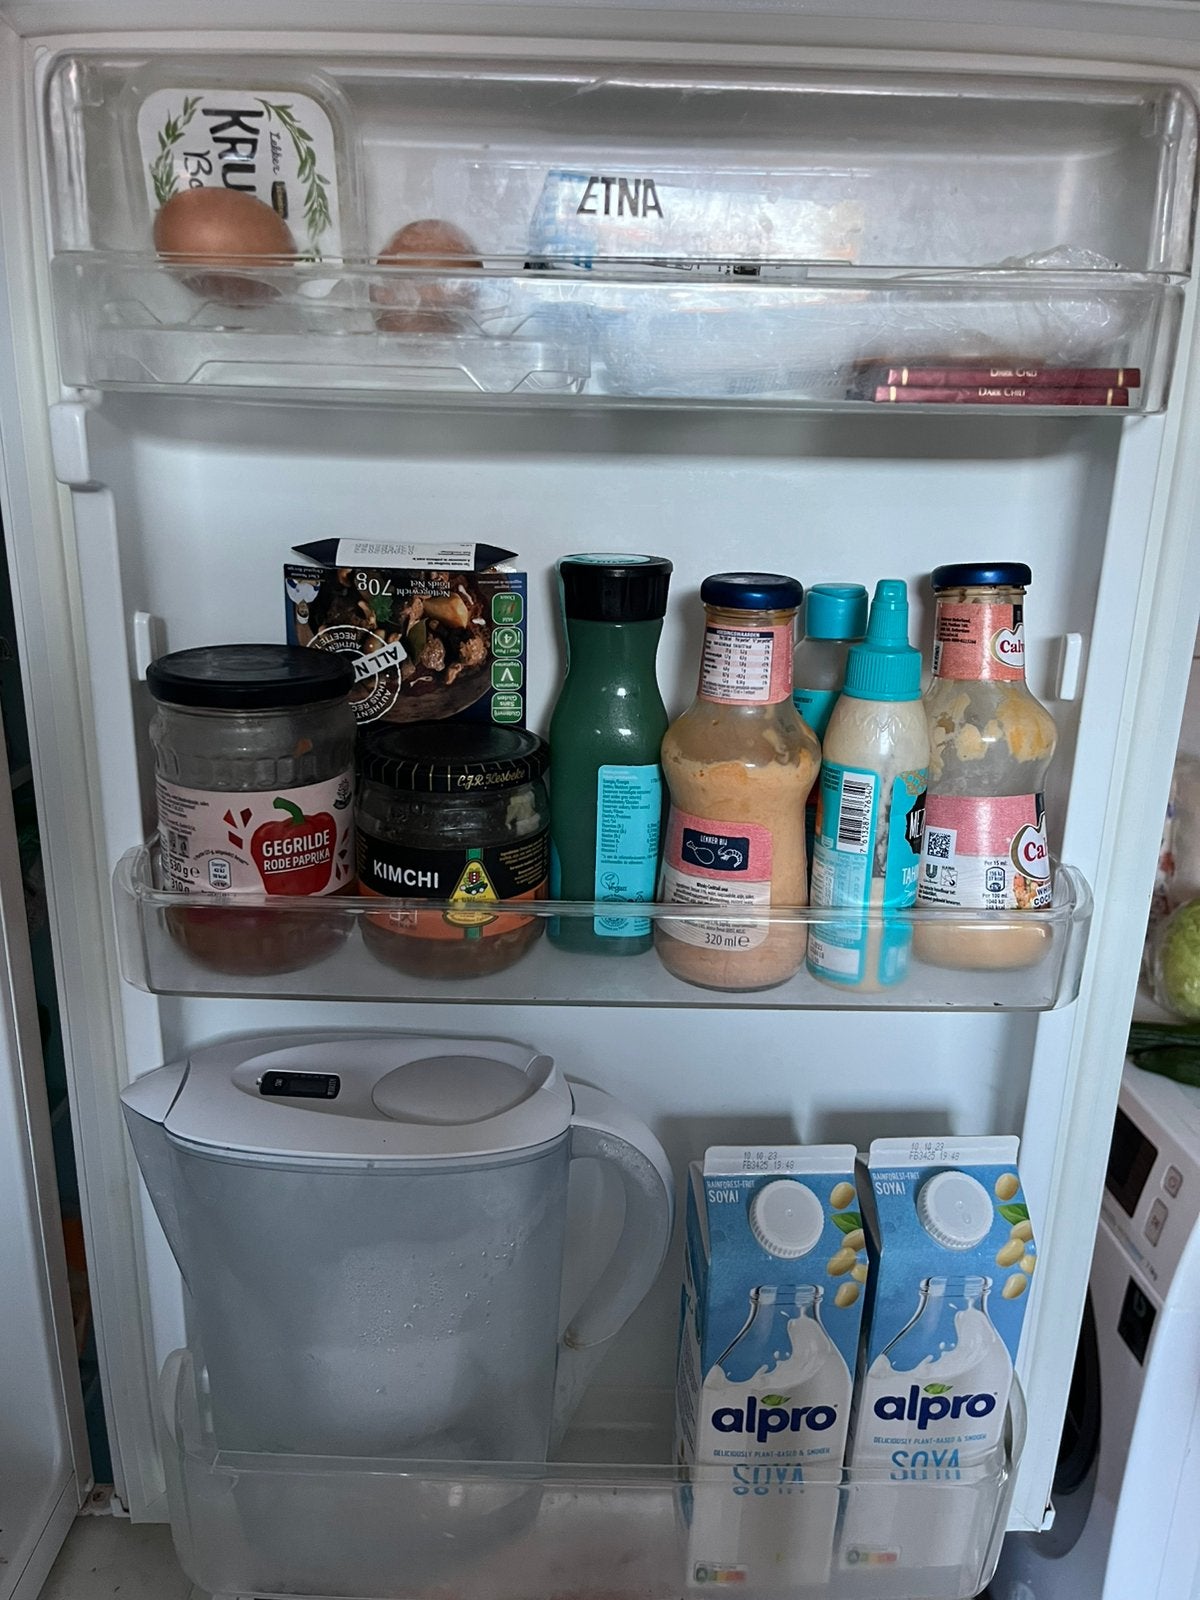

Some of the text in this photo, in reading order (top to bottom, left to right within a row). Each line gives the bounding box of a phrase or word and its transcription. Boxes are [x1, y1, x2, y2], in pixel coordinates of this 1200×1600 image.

[201, 108, 264, 192] KRU
[269, 131, 282, 175] Lekker
[576, 175, 664, 219] ETNA
[356, 572, 392, 596] 70g
[396, 586, 450, 598] Nettogewicht
[425, 579, 450, 589] Poids
[320, 631, 357, 645] RECETTE
[503, 633, 512, 643] 4
[368, 646, 398, 668] ALL
[501, 667, 514, 681] V
[352, 704, 370, 712] REC
[356, 689, 391, 718] AUTHENT
[262, 829, 330, 857] GEGRILDE
[700, 834, 719, 845] LEKKER
[263, 857, 292, 871] RODE
[292, 847, 331, 867] PAPRIKA
[170, 860, 182, 874] 530
[183, 866, 189, 878] g
[373, 859, 439, 889] KIMCHI
[704, 932, 722, 945] 320
[724, 935, 737, 947] ml
[706, 1180, 755, 1189] RAINFOREST-FREE
[872, 1171, 920, 1181] RAINFOREST-FREE
[708, 1189, 740, 1204] SOYA!
[875, 1182, 906, 1196] SOYA!
[873, 1385, 997, 1430] alpro
[711, 1396, 837, 1442] alpro
[890, 1448, 961, 1480] SOYA
